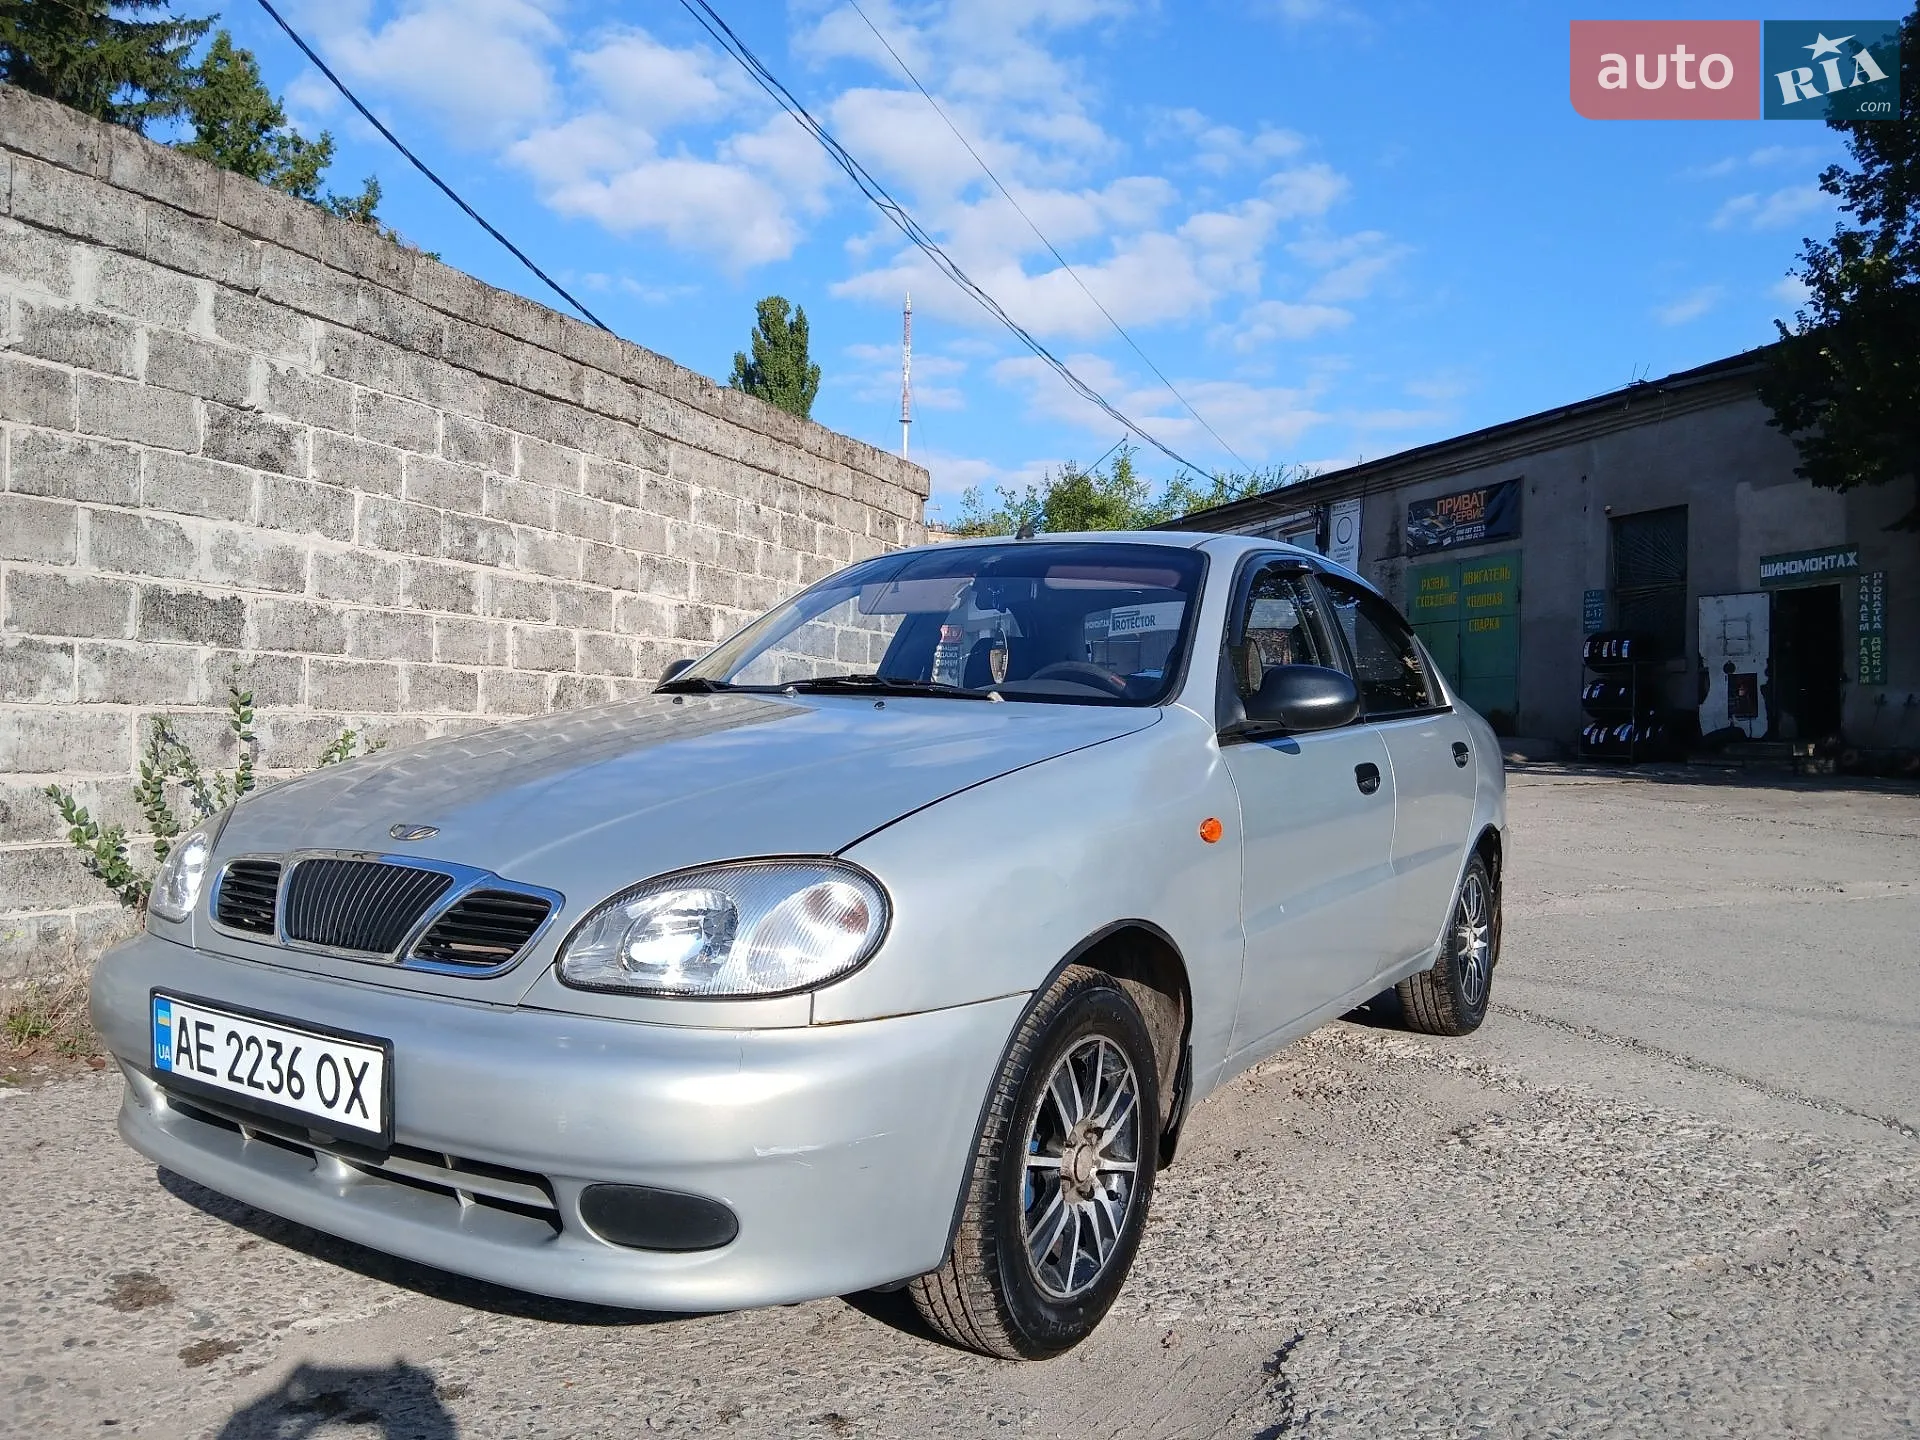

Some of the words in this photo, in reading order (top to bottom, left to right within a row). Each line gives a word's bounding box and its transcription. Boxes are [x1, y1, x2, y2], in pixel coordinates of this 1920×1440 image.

[1436, 490, 1487, 516] ПРИВАТ
[1450, 507, 1485, 523] СЕРВИС
[1760, 552, 1858, 578] ШИНОМОНТАЖ
[1859, 575, 1869, 631] КАЧАЕМ
[1872, 571, 1883, 629] ПРОКАТКА
[1860, 637, 1869, 684] ГАЗОМ
[158, 1043, 171, 1061] UA
[175, 1016, 217, 1077] AE
[225, 1030, 305, 1100] 2236
[316, 1052, 369, 1119] OX
